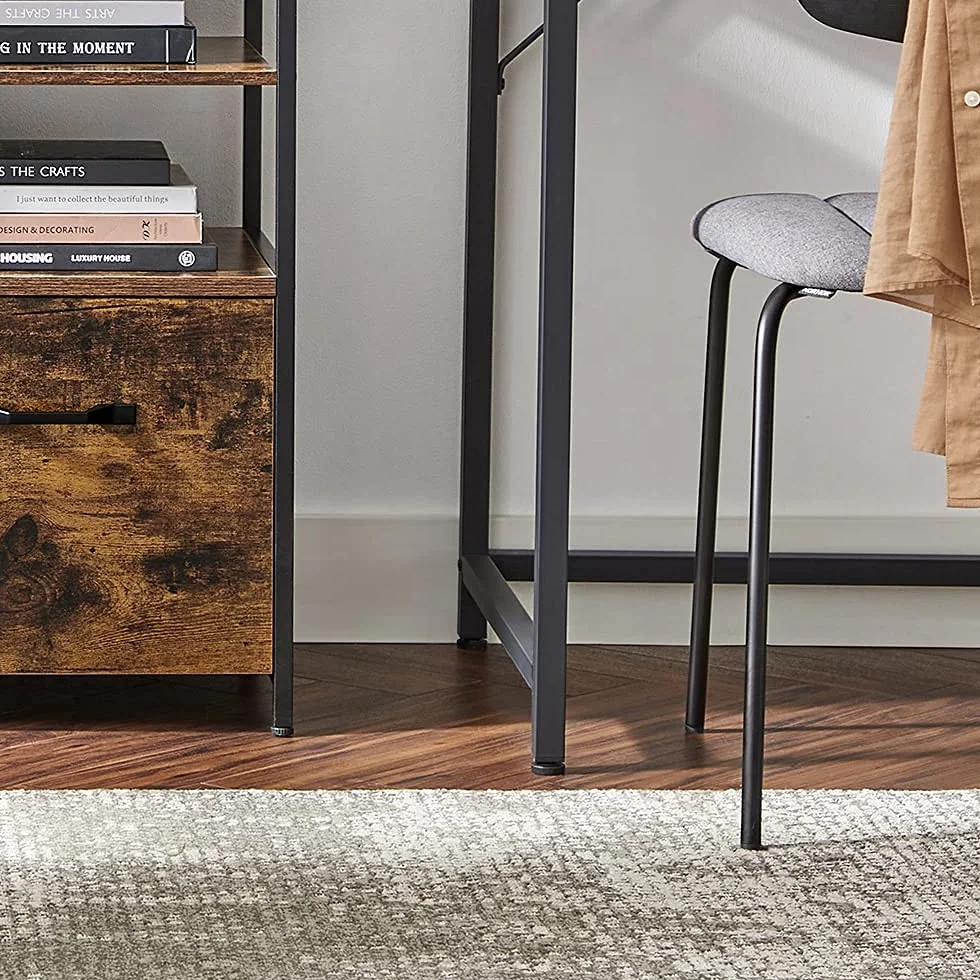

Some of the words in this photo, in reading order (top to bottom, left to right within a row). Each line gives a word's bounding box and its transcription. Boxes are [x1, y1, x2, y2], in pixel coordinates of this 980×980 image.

[5, 8, 51, 19] CRAFTS
[55, 8, 81, 19] THE
[85, 8, 116, 19] ARTS
[17, 42, 31, 54] IN
[37, 42, 66, 54] THE
[73, 42, 135, 54] MOMENT
[10, 166, 35, 177] THE
[40, 166, 86, 177] CRAFTS
[20, 195, 36, 204] just
[67, 195, 93, 203] collect
[94, 195, 107, 203] the
[108, 195, 143, 203] beautiful
[144, 195, 169, 204] things
[30, 226, 38, 234] &
[39, 226, 95, 234] DECORATING
[0, 253, 53, 263] HOUSING
[71, 254, 103, 262] LUXURY
[103, 254, 131, 263] HOUSE
